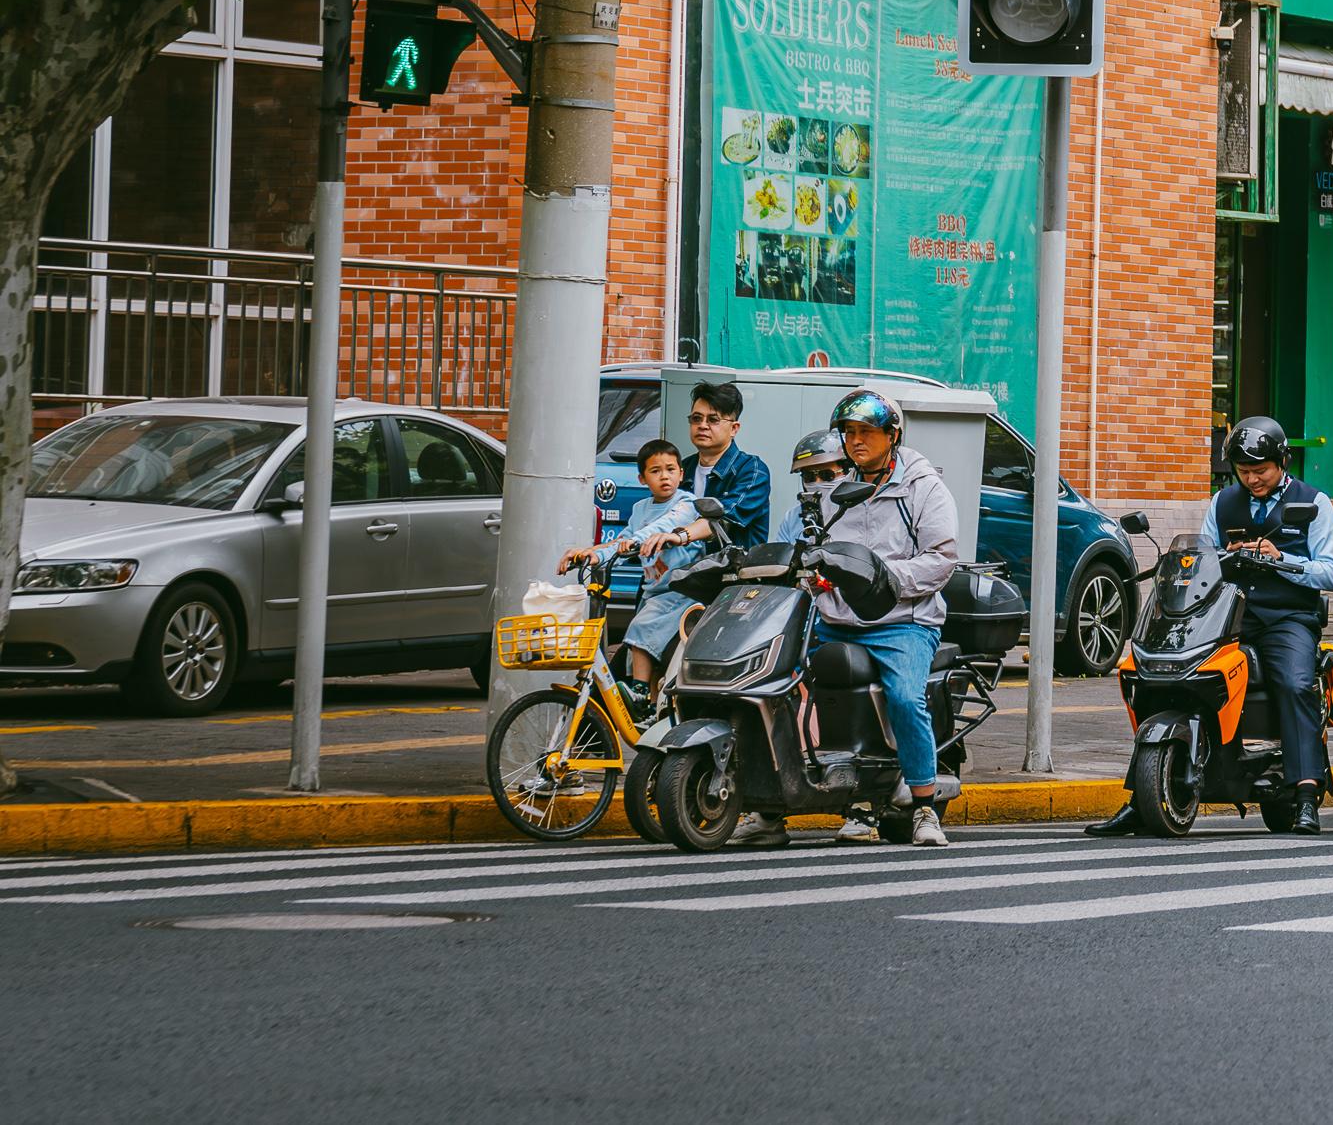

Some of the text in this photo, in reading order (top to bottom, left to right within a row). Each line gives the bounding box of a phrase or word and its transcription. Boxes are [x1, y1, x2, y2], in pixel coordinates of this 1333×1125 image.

[895, 28, 935, 51] Lunch
[786, 50, 870, 78] BISTRO & BBQ
[798, 77, 871, 118] 士兵突击
[937, 212, 967, 237] BBQ
[936, 266, 970, 290] 118元
[755, 310, 823, 338] 军人与老兵
